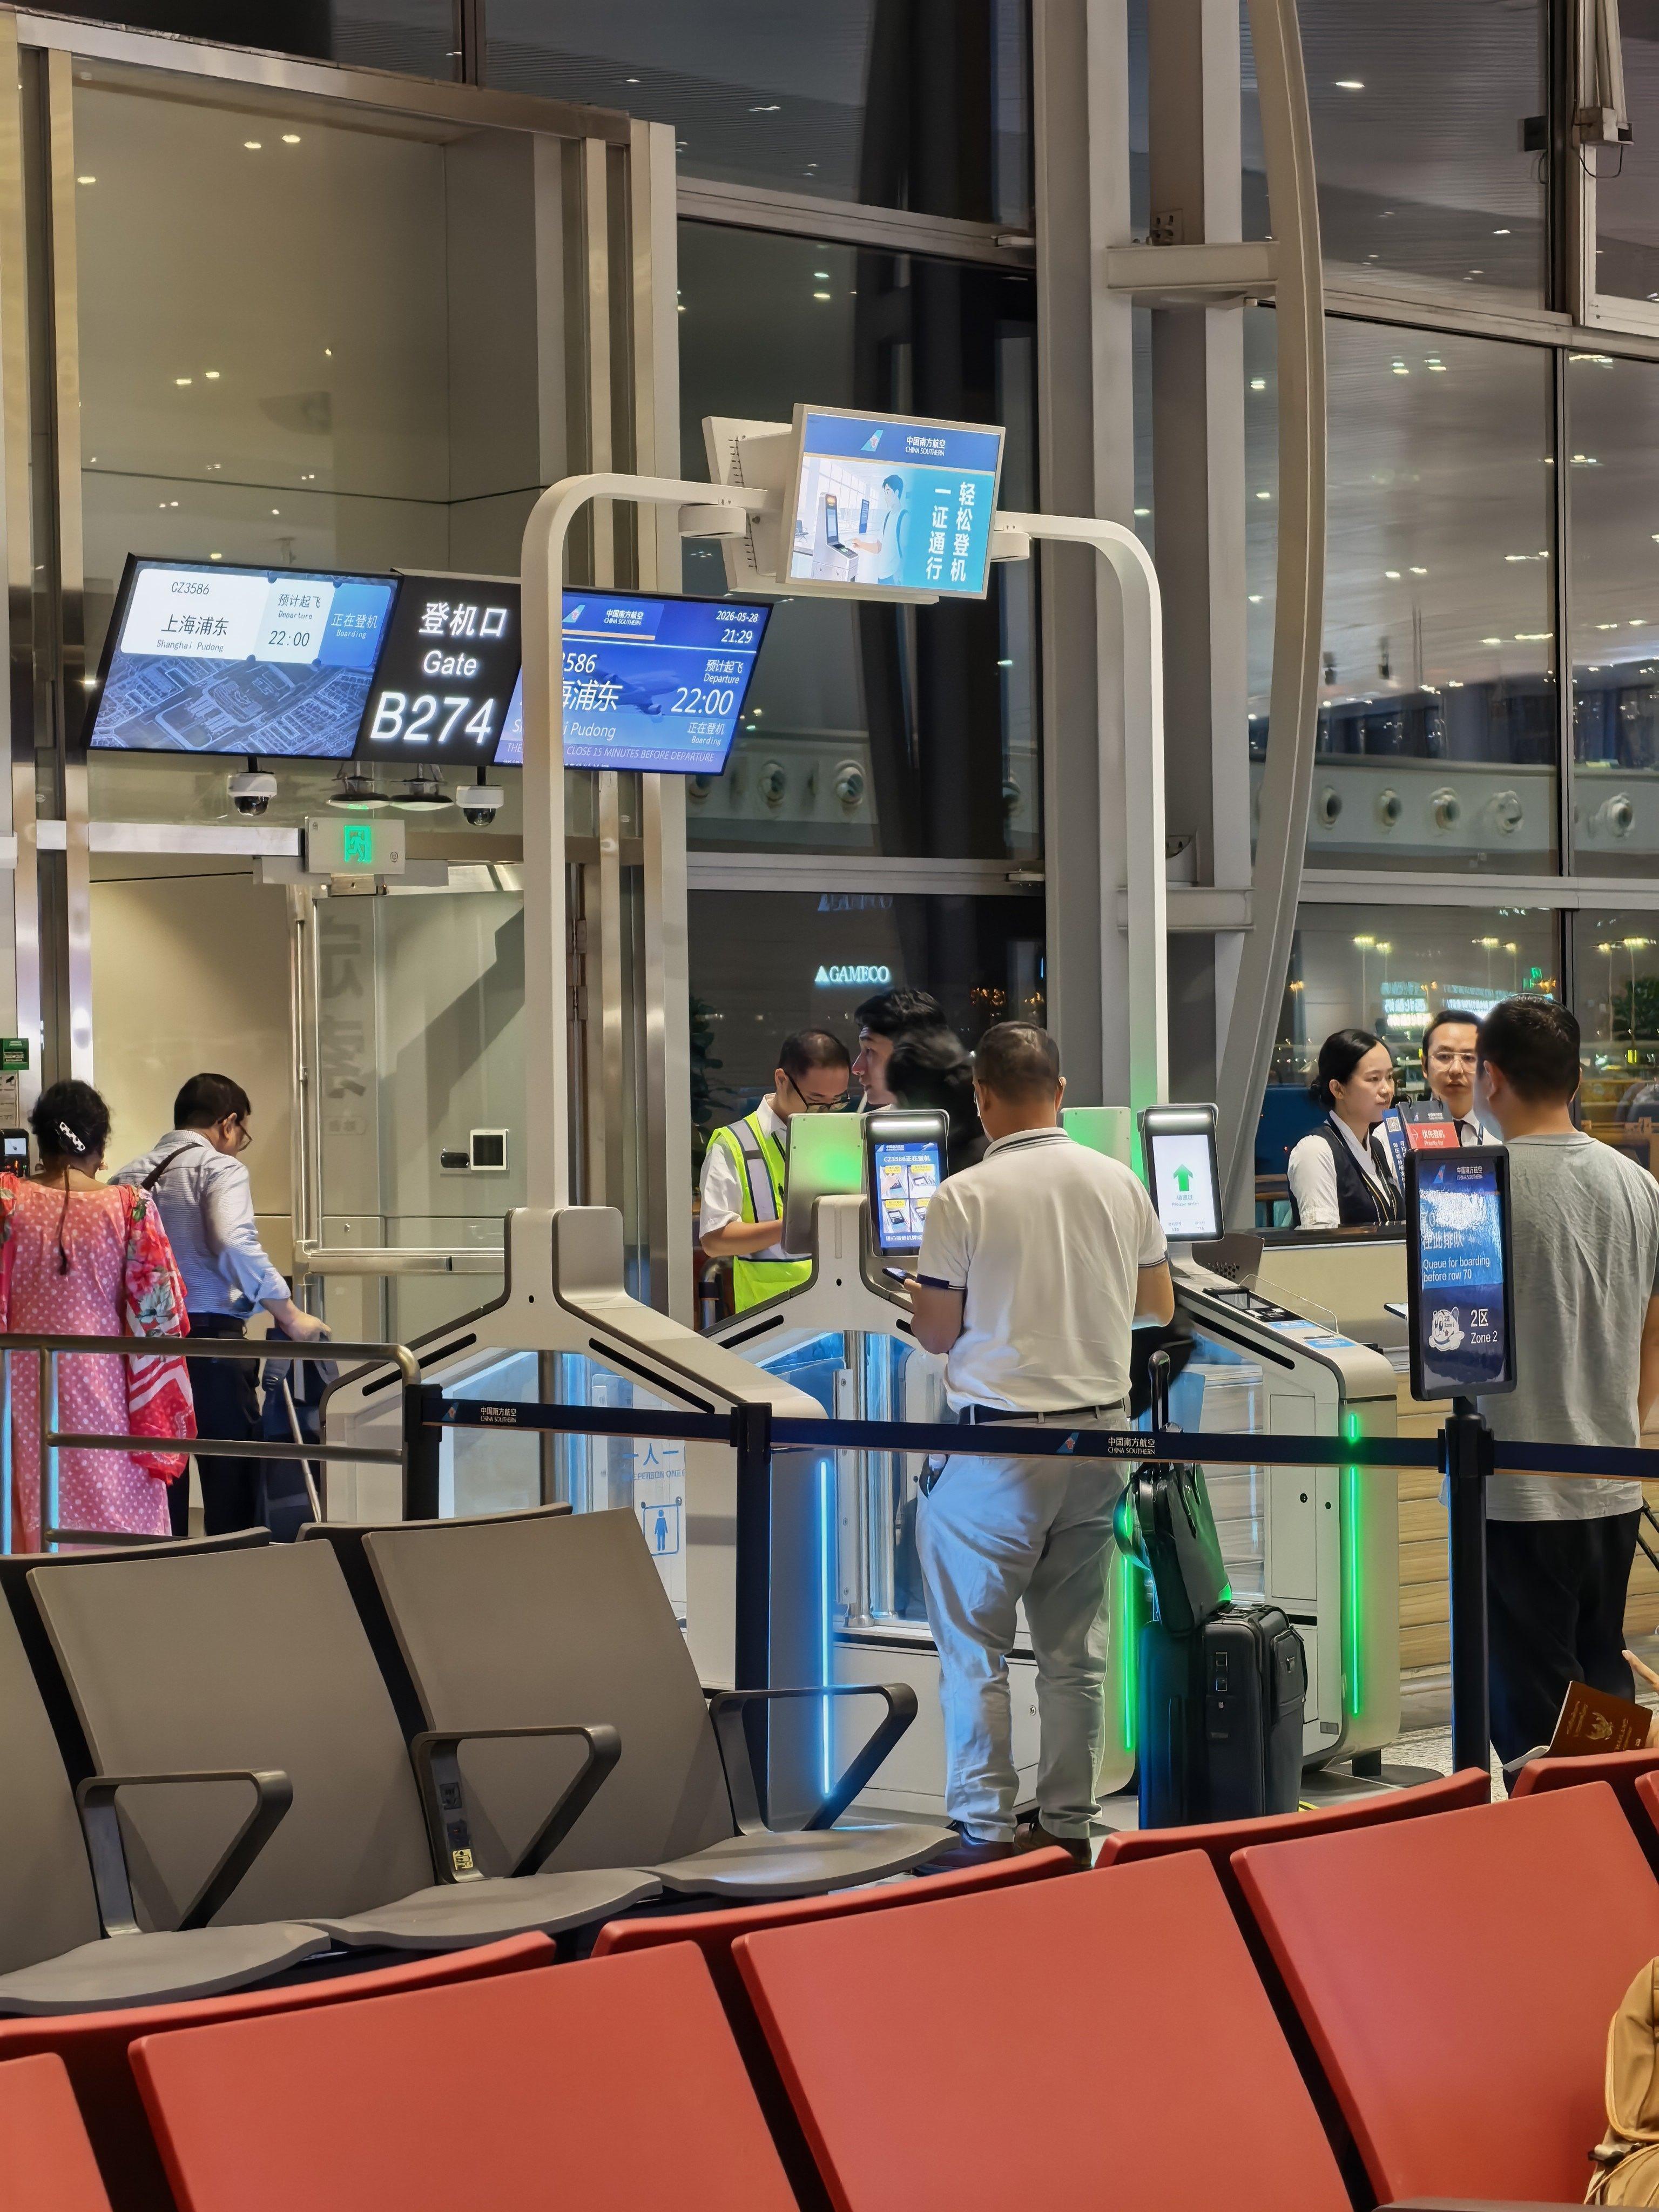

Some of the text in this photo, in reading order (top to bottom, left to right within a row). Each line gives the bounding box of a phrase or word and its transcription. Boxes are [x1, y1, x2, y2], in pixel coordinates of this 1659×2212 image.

[906, 435, 946, 449] 中国南方航空
[920, 448, 945, 456] SOUTHERN
[926, 488, 952, 580] 一证通行
[950, 482, 975, 582] 轻松登机
[171, 582, 210, 595] CZ3586
[278, 594, 321, 608] 预计起飞
[278, 611, 313, 619] Departure
[331, 613, 378, 629] 正在登机
[419, 602, 507, 637] 登机口
[606, 609, 644, 619] 中国南方航空
[716, 611, 759, 623] 2026-05-28
[161, 613, 230, 636] 上海浦东
[268, 630, 310, 646] 22:00
[336, 630, 367, 639] Boarding
[721, 629, 753, 644] 21:29
[157, 639, 224, 652] Shanghai Pudong
[423, 650, 478, 676] Gate
[562, 652, 597, 673] 586
[704, 659, 744, 673] 预计起飞
[704, 674, 739, 684] Departure
[671, 687, 734, 715] 22:00
[370, 691, 494, 744] B274
[570, 723, 616, 741] Pudong
[687, 722, 725, 735] 正在登机
[691, 736, 721, 746] Boarding
[567, 746, 591, 756] CLOSE
[604, 747, 639, 759] MINUTES
[640, 750, 669, 760] BEFORE
[670, 751, 715, 762] DEPARTURE
[829, 966, 891, 982] GAMECO
[1423, 1255, 1490, 1272] Queue for boarding
[1424, 1269, 1472, 1282] before row 70
[1471, 1309, 1489, 1327] 2区
[1471, 1330, 1498, 1344] Zone 2
[481, 1406, 517, 1417] 中国南方航空
[1108, 1436, 1155, 1447] 中国南方航空
